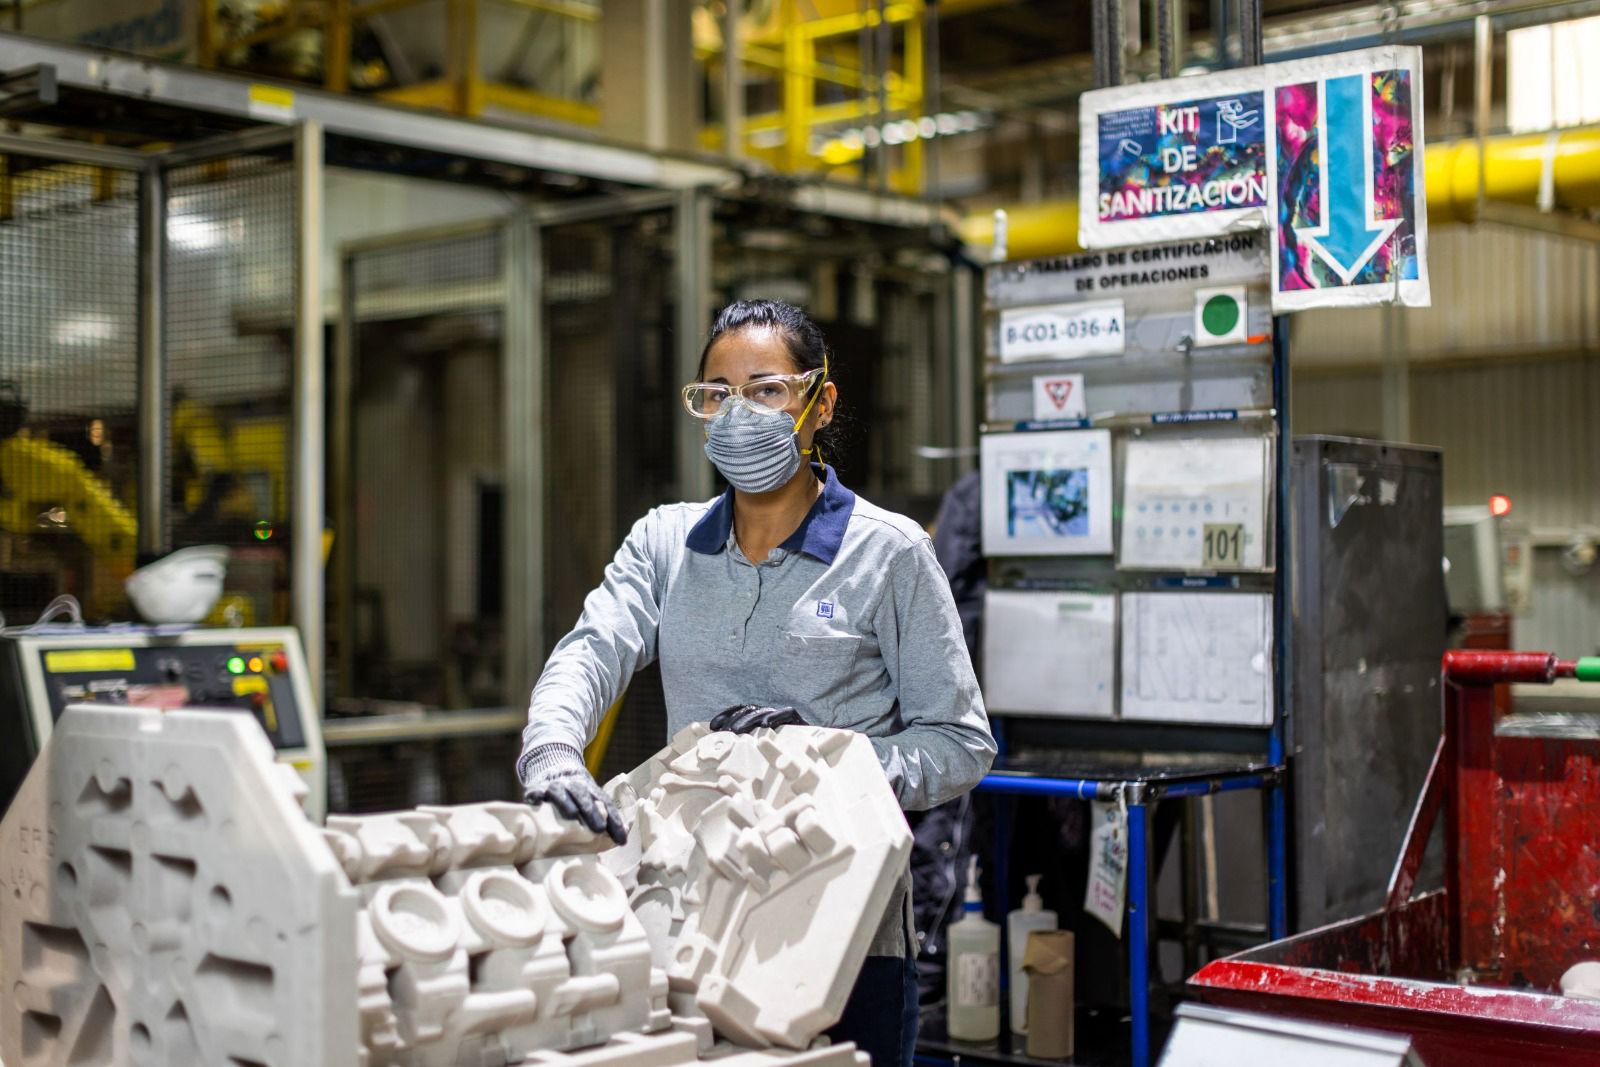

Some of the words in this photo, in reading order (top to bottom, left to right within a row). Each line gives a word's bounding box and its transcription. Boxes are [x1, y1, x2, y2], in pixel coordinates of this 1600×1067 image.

[1160, 106, 1199, 135] KIT
[1163, 145, 1198, 173] DE
[1099, 171, 1267, 218] SANITIZACIÓN
[1107, 252, 1126, 266] DE
[1076, 278, 1094, 291] DE
[1100, 264, 1210, 289] OPERACIONES
[1204, 529, 1240, 561] 101
